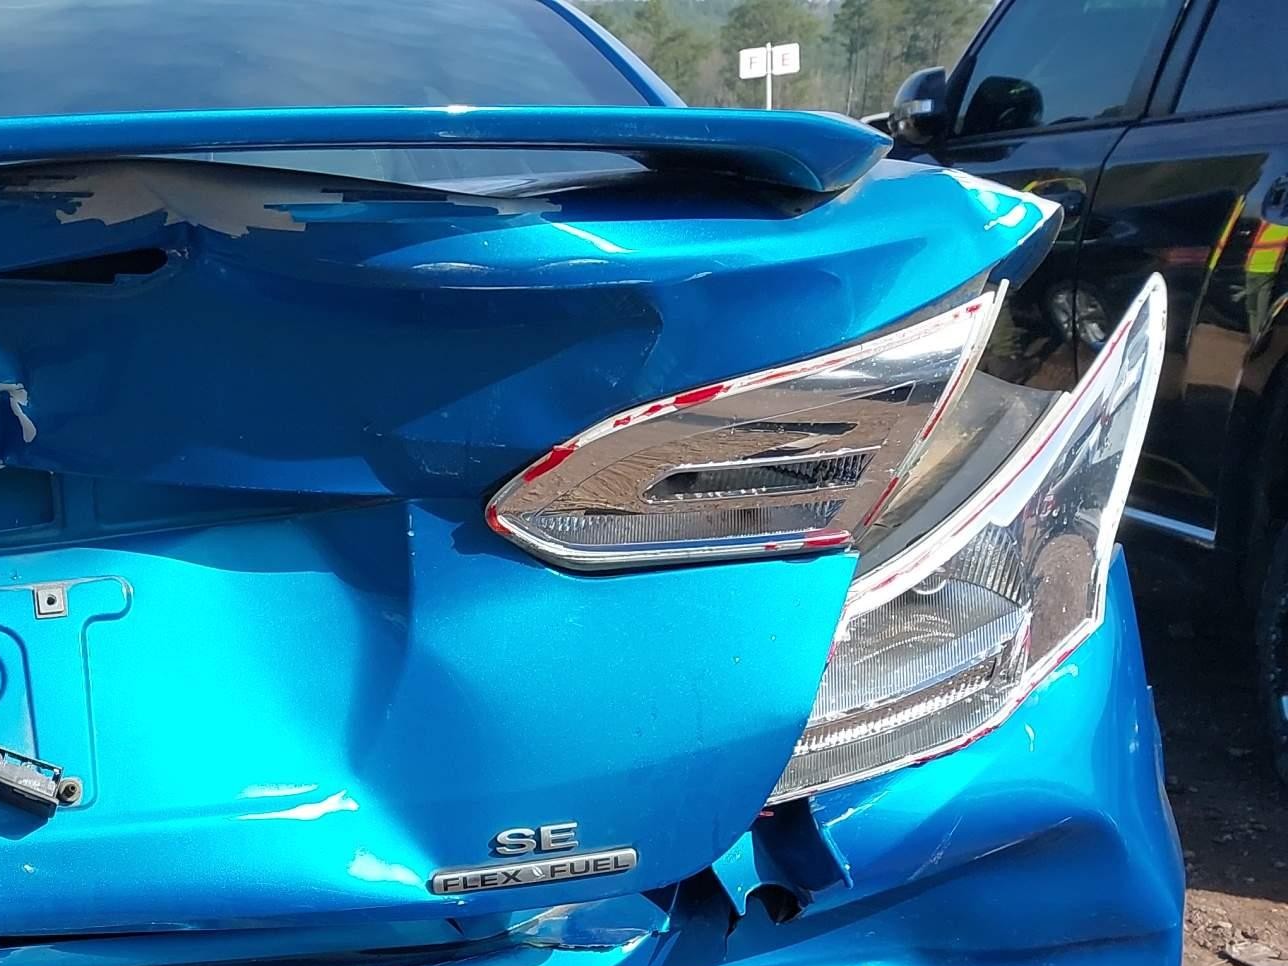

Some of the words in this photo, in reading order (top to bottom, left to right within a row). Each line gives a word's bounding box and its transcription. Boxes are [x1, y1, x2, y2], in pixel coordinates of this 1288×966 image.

[496, 821, 579, 856] SE
[442, 868, 522, 892] FLEX
[549, 855, 630, 879] FUEL
